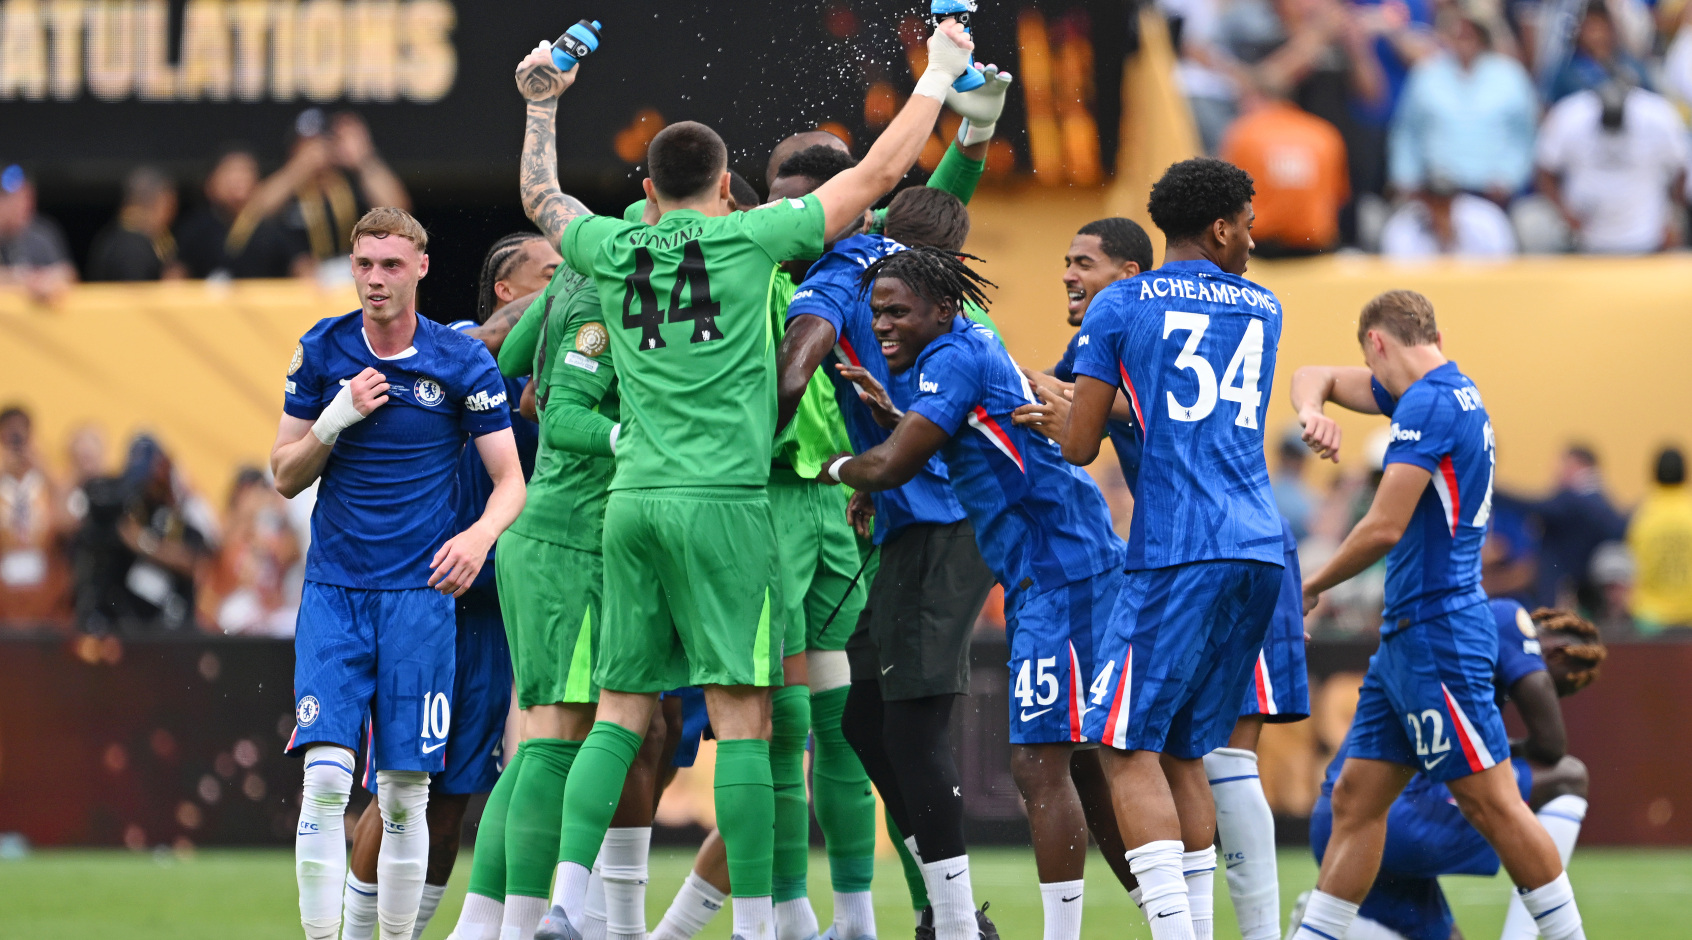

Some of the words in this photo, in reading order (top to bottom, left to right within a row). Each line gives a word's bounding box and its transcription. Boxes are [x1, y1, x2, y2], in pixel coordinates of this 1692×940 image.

[622, 239, 725, 352] 44
[1140, 277, 1278, 315] ACHEAMPONG
[1162, 310, 1264, 430] 34
[1014, 655, 1059, 707] 45
[420, 691, 451, 739] 10
[1407, 708, 1451, 756] 22
[300, 820, 319, 831] CFC
